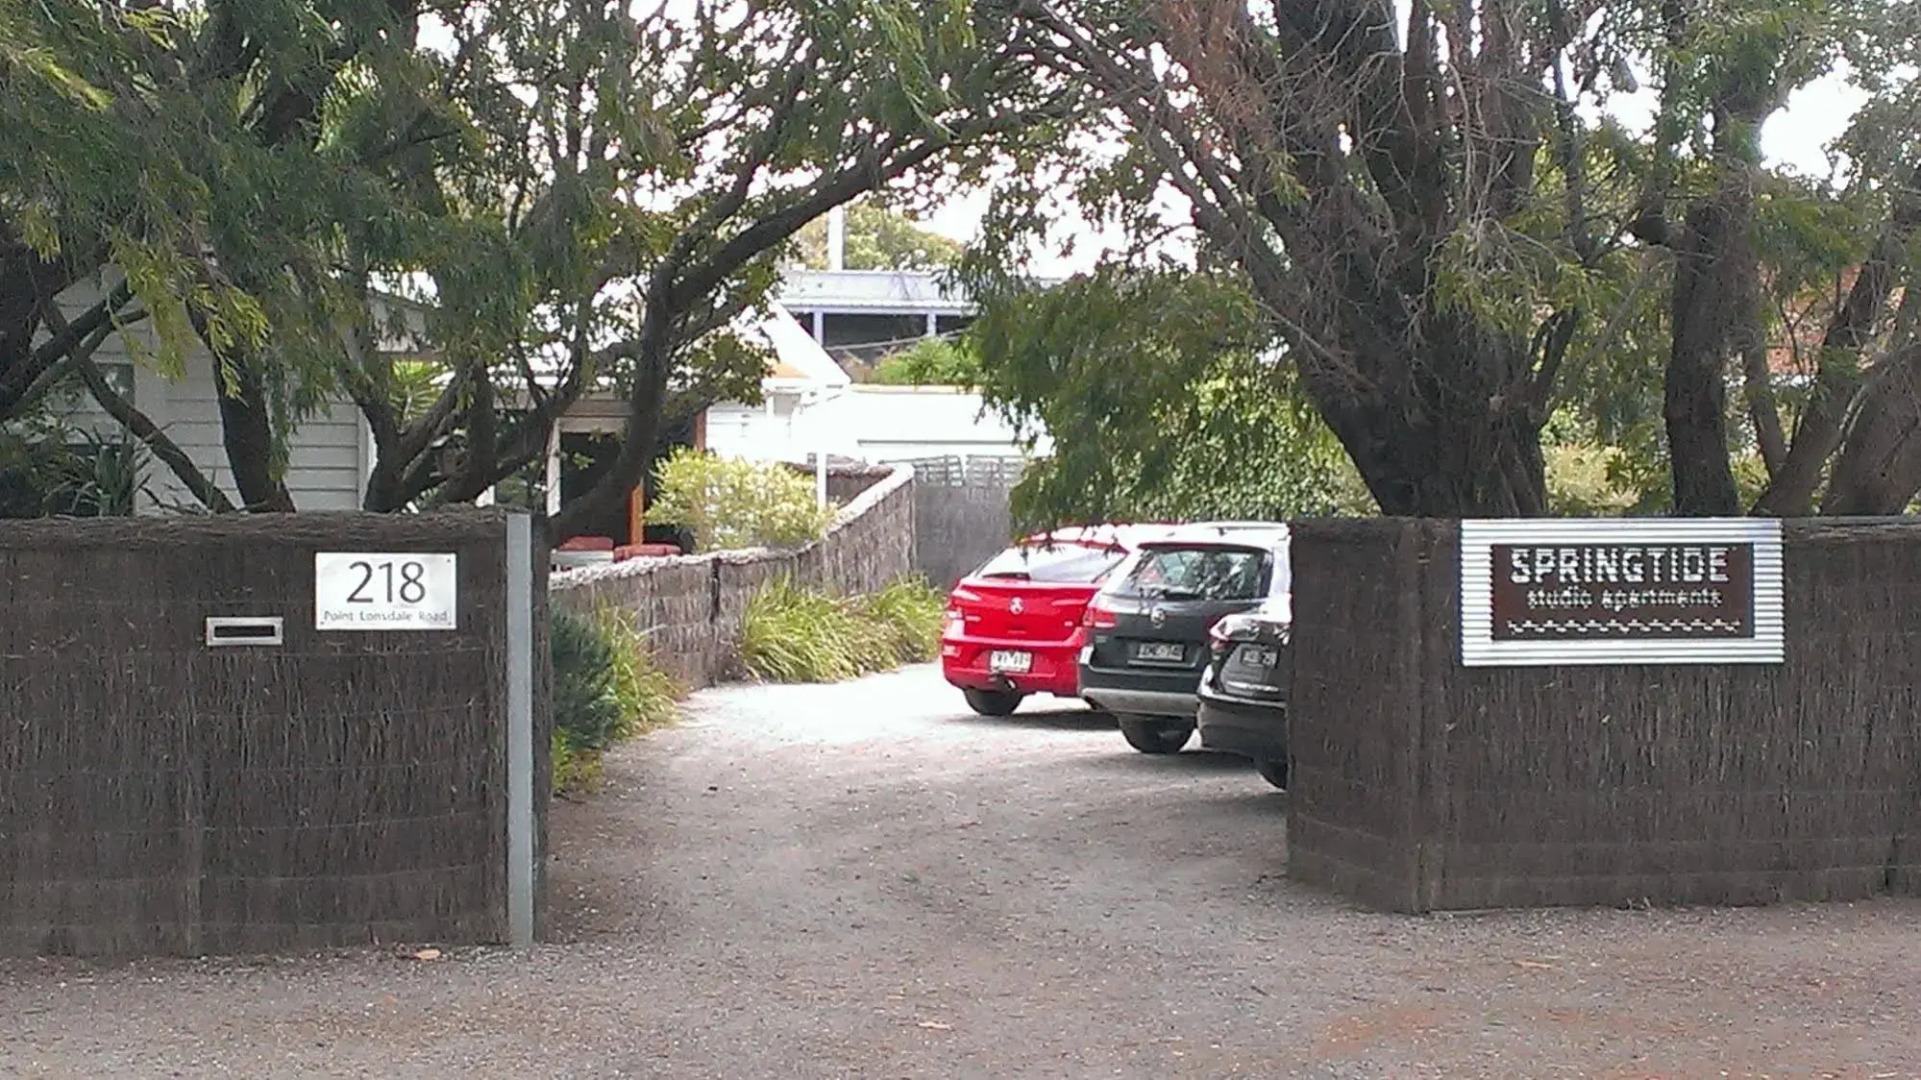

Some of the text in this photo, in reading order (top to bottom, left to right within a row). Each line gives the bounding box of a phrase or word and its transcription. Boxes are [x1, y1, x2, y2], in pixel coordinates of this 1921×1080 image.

[1509, 547, 1730, 584] SPRINGTIDE
[346, 561, 426, 603] 218
[1526, 586, 1723, 612] studio apartments
[324, 610, 449, 622] Point Lonsdale Road
